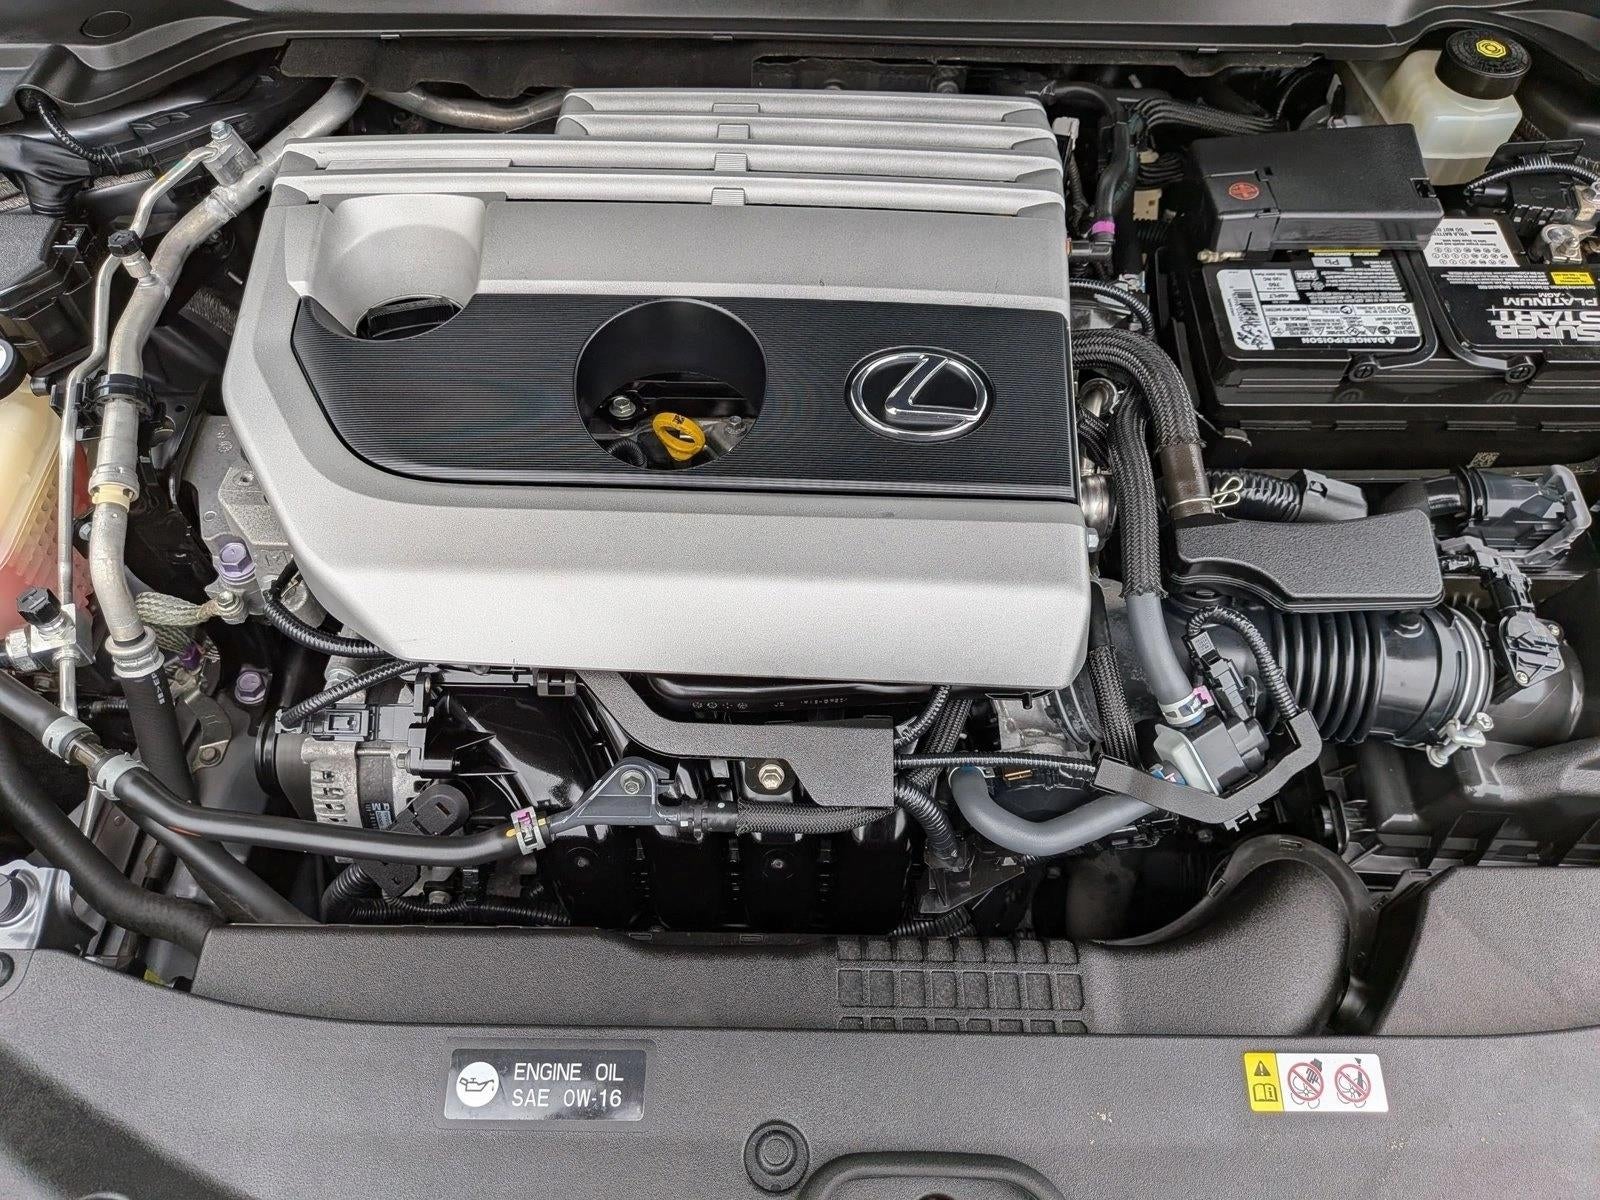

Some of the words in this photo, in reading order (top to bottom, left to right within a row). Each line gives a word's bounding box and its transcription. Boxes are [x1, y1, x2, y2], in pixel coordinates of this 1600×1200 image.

[1502, 297, 1598, 306] PLATINUM
[1488, 311, 1600, 326] START
[1494, 324, 1600, 341] SUPER
[513, 1062, 582, 1081] ENGINE
[595, 1063, 624, 1081] OIL
[512, 1088, 550, 1107] SAE
[564, 1088, 622, 1107] 0W-16
